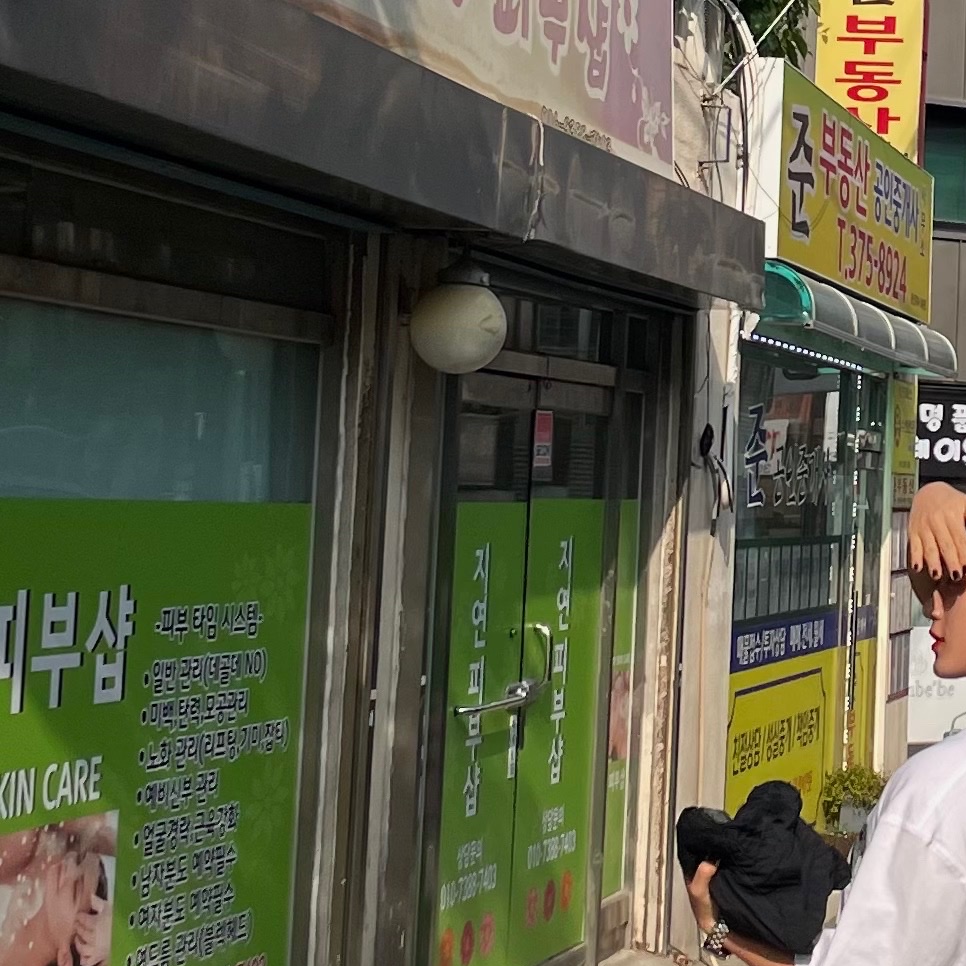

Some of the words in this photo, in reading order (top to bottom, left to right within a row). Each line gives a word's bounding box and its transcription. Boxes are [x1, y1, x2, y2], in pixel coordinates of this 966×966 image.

[787, 110, 815, 239] 준
[820, 111, 871, 218] 부동산
[873, 160, 920, 244] 공인중개사
[192, 602, 217, 641] 타임
[42, 755, 104, 811] CARE
[195, 768, 220, 805] 관리
